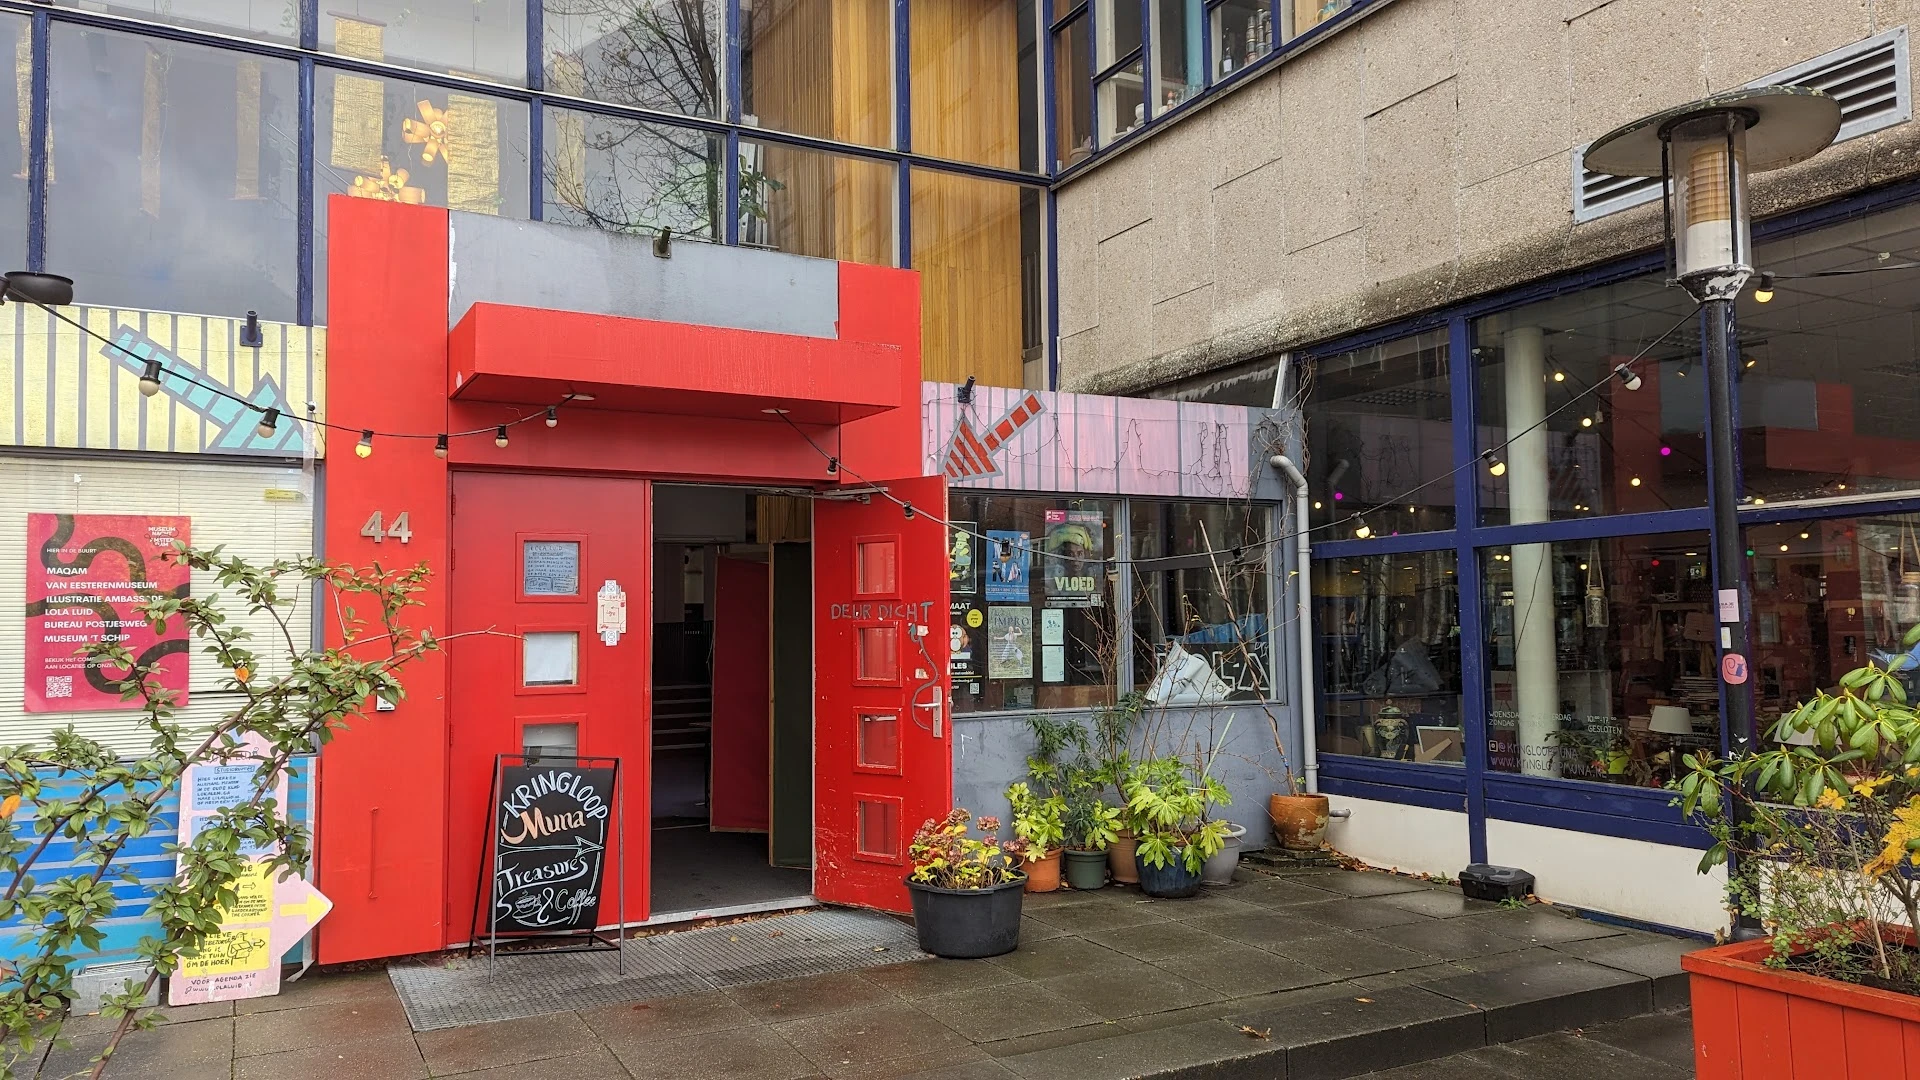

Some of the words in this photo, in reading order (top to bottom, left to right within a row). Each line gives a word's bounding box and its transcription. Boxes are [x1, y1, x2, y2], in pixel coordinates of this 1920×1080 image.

[360, 511, 413, 544] 44
[46, 567, 88, 576] MAQAM
[46, 582, 67, 590] VAN
[70, 582, 158, 590] EESTERENMUSEUM
[1054, 576, 1095, 591] VLOED
[46, 595, 102, 603] ILLUSTRATIE
[44, 608, 69, 616] LOLA
[72, 608, 94, 616] LUID
[830, 603, 872, 620] DEUR
[878, 601, 935, 623] DICHT
[44, 621, 83, 629] BUREAU
[86, 620, 148, 628] POSTJESWEG
[994, 616, 1030, 627] IMPRO
[44, 635, 88, 643] MUSEUM
[101, 634, 131, 642] SCHIP
[1488, 719, 1515, 727] ZONDAG
[1588, 724, 1622, 735] GESLOTEN
[502, 770, 609, 820] KRINGLOOP
[500, 806, 587, 845] Muna
[496, 855, 590, 890] Treasures
[554, 887, 597, 926] Coffee
[186, 960, 198, 968] OM
[210, 958, 230, 966] HOEK
[214, 975, 243, 983] AGENDA
